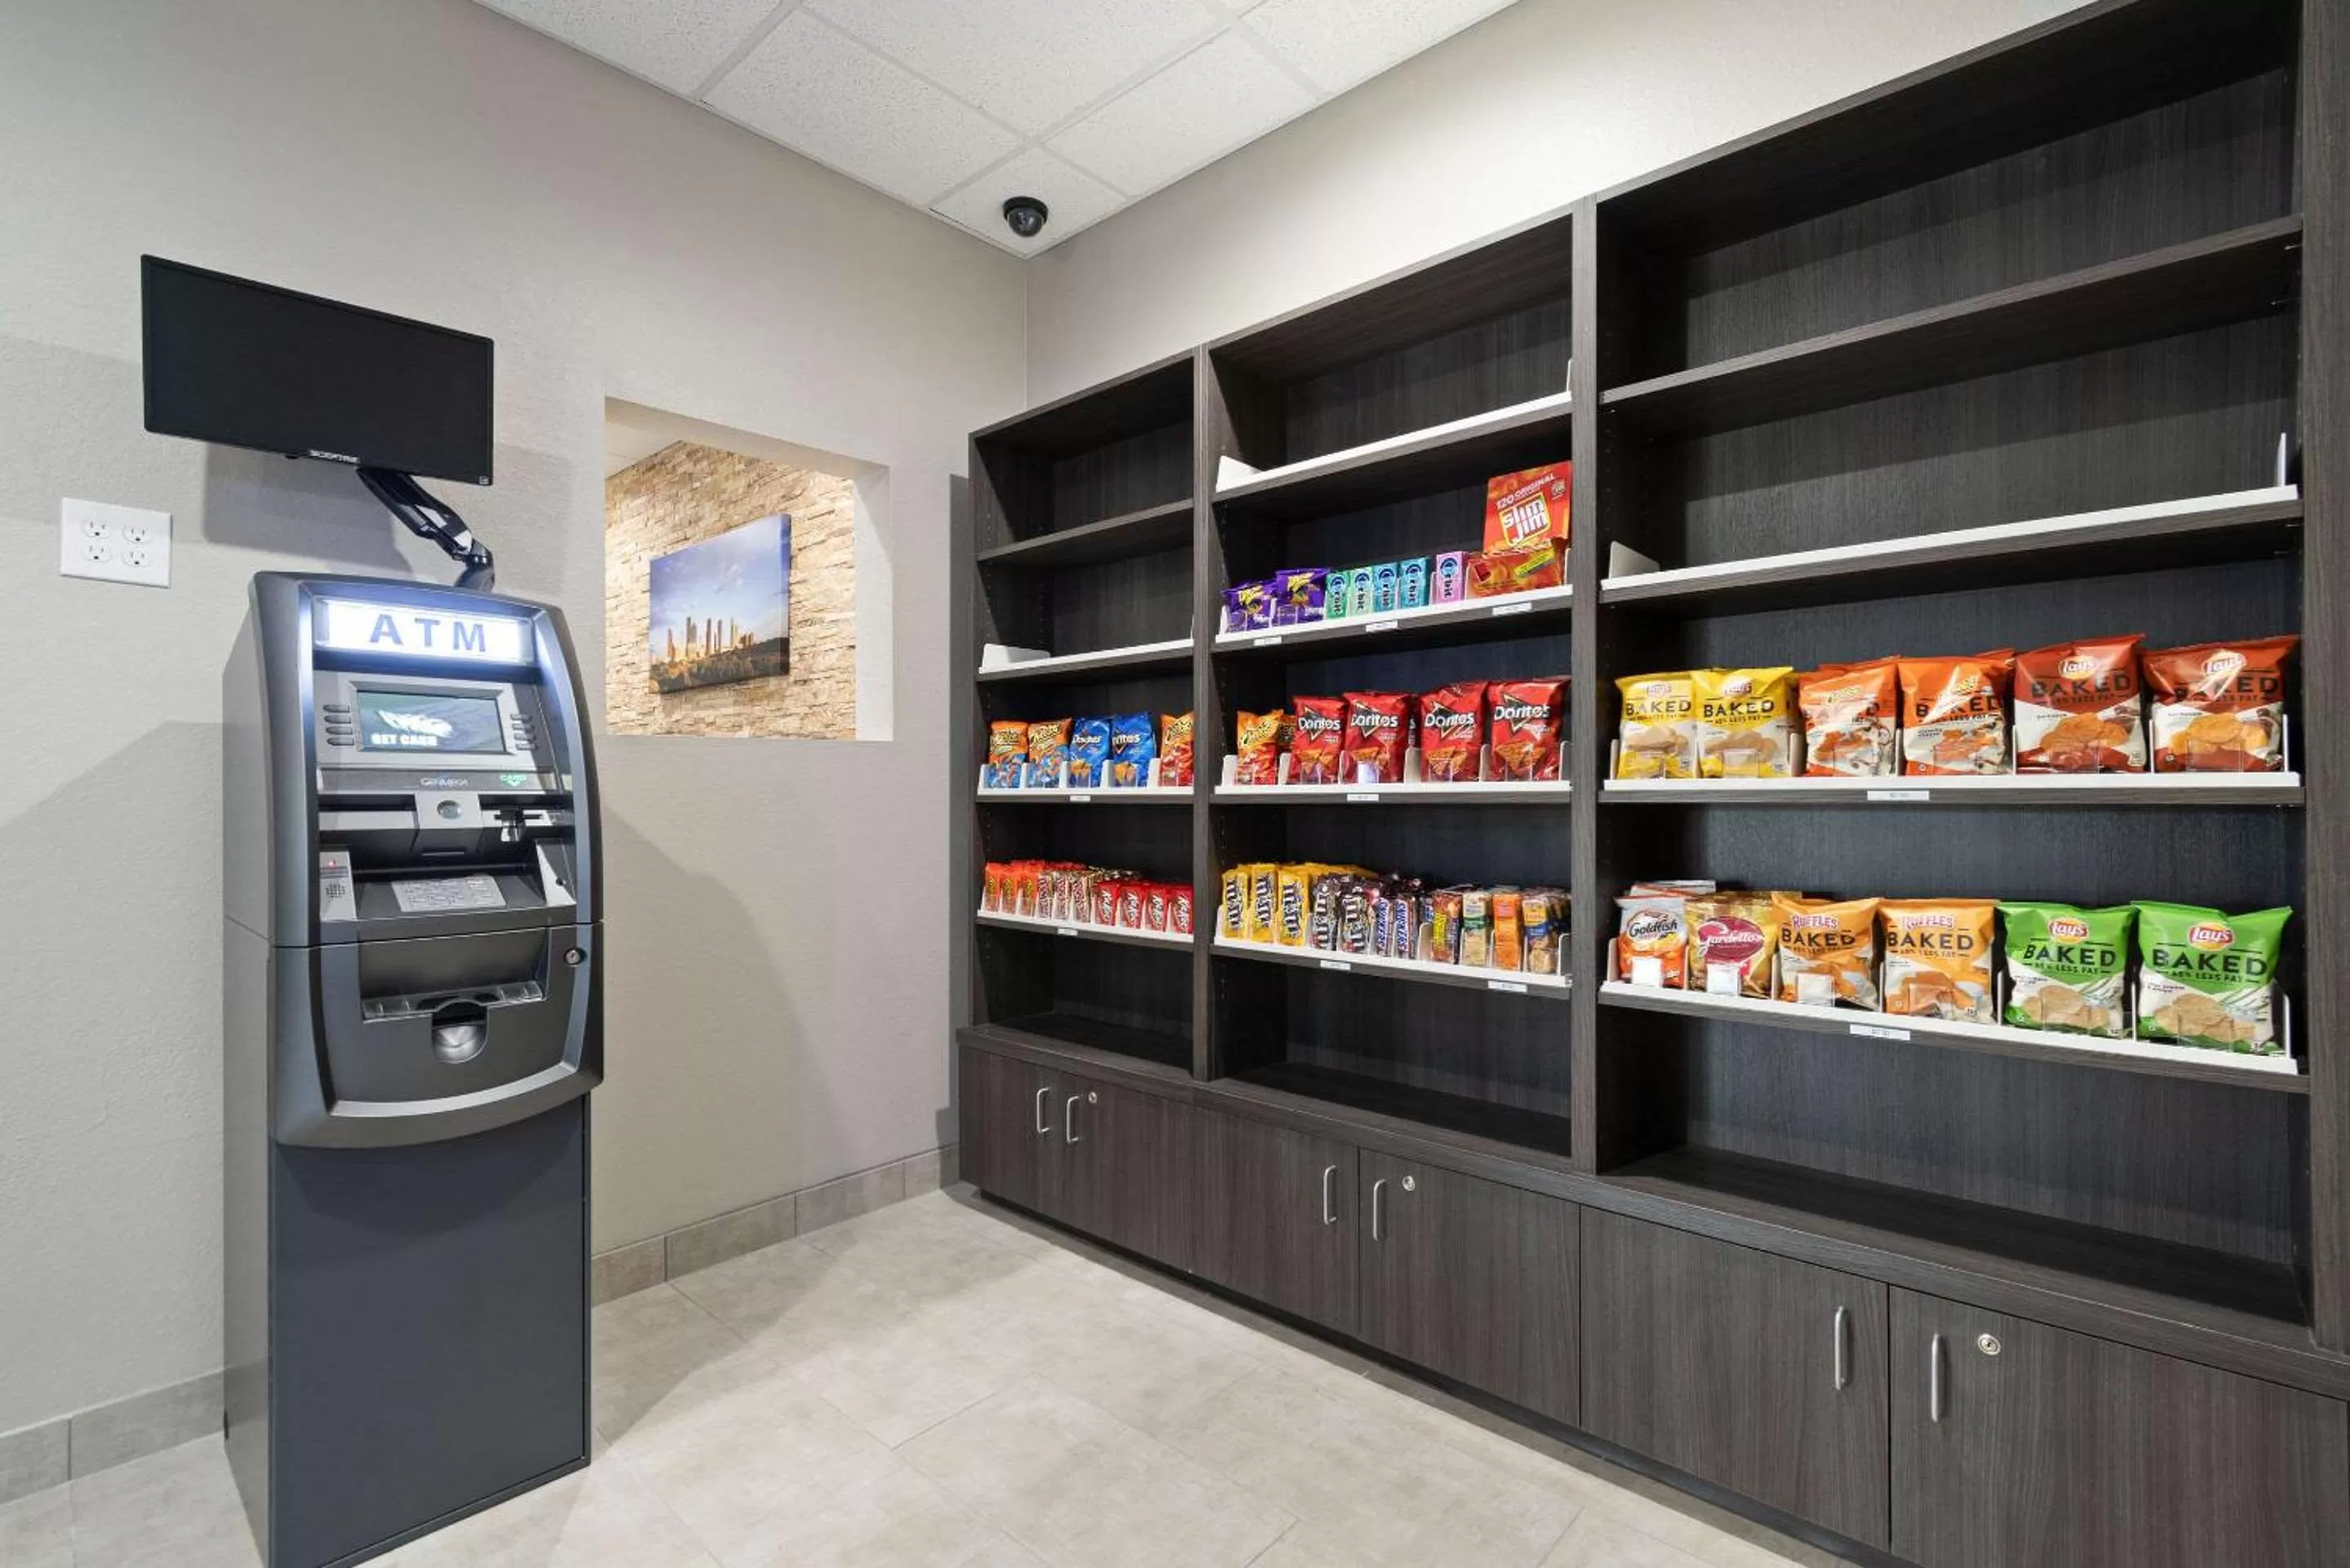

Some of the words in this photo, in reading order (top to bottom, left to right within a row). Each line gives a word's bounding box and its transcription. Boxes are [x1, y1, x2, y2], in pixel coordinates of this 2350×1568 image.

[370, 613, 487, 653] ATM
[1494, 704, 1550, 721] Doritos
[1704, 700, 1774, 717] BAKED
[1298, 717, 1340, 731] Doritos
[1350, 713, 1398, 727] Doritos
[1424, 712, 1476, 727] Doritos
[1629, 919, 1677, 937] Goldfish
[1792, 914, 1837, 928] RUFFLES
[1782, 928, 1855, 947] BAKED
[1887, 931, 1973, 950] BAKED
[2192, 927, 2230, 942] Lay's
[2023, 944, 2116, 967] BAKED
[2152, 948, 2268, 975] BAKED
[2081, 966, 2099, 975] FAT
